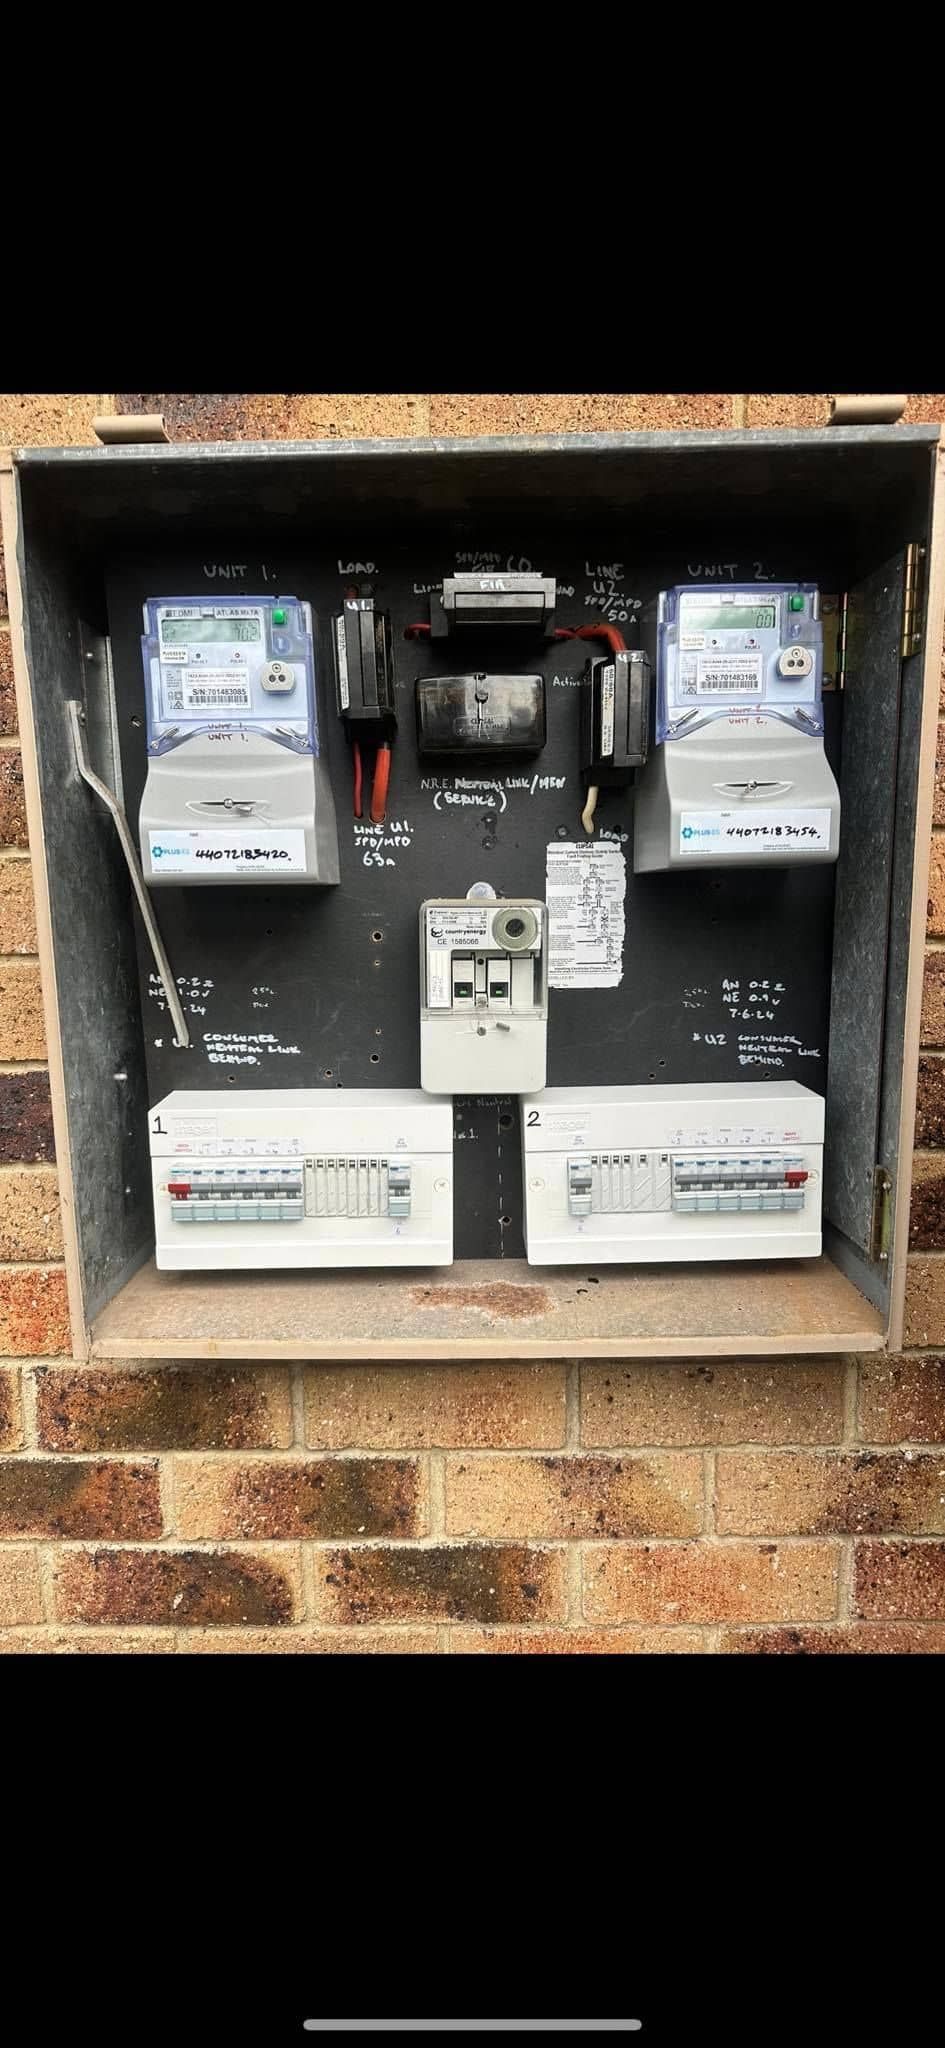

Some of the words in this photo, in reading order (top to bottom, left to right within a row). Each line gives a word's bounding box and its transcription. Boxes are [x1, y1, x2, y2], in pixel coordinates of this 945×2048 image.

[204, 565, 247, 578] UNIT
[262, 565, 277, 581] 1.
[337, 560, 379, 574] LOAD.
[585, 561, 624, 580] LINE
[688, 564, 738, 579] UNIT
[753, 562, 775, 580] 2.
[593, 580, 625, 597] U2.
[584, 595, 642, 613] SPD/MPD
[353, 825, 384, 835] LINE
[390, 820, 414, 833] U1.
[354, 836, 411, 851] SPD/MPD
[444, 928, 487, 936] countryenergy
[722, 979, 740, 991] AN
[722, 992, 740, 1003] NE
[202, 1033, 279, 1044] CONSUMER
[737, 1034, 803, 1046] CONSUMER
[267, 1045, 301, 1054] LINK
[797, 1047, 821, 1057] LINK
[152, 1116, 168, 1135] 1
[526, 1111, 541, 1127] 2
